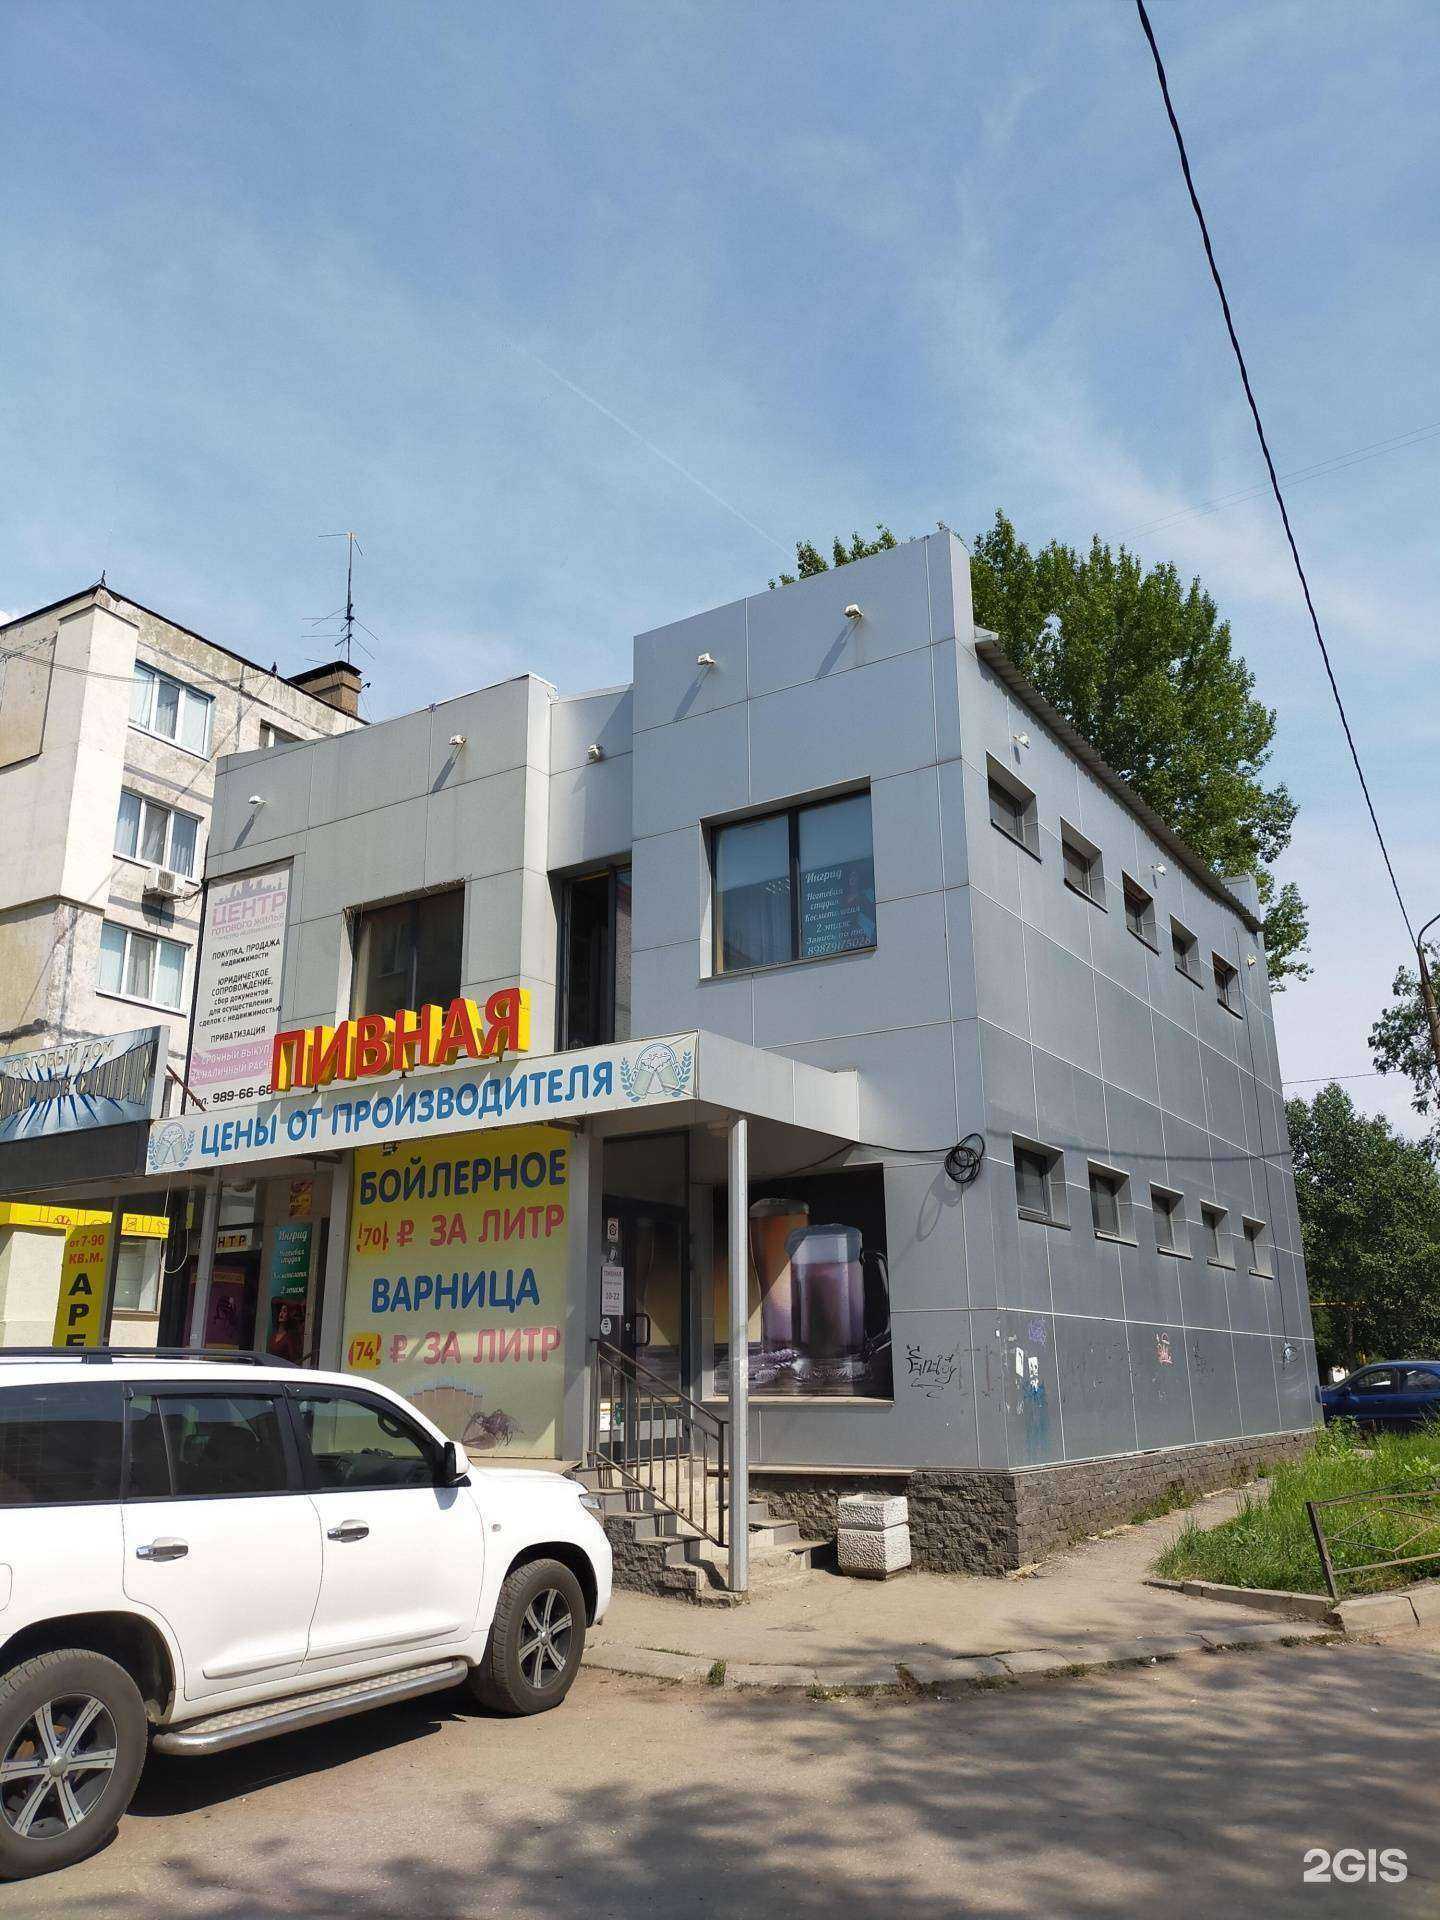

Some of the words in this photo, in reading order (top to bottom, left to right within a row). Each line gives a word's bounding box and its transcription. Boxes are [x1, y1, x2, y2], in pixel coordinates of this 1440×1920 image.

[212, 892, 287, 929] ЦЕНТР
[212, 946, 245, 961] ПОКУПКА,
[246, 938, 281, 953] ПРОДАЖА
[221, 951, 269, 968] недвижимости
[217, 967, 270, 987] ЮРИДИЧЕСКОЕ
[208, 1006, 221, 1018] для
[222, 997, 273, 1014] осуществления
[214, 995, 229, 1006] сбор
[229, 988, 269, 1004] документов
[199, 1015, 222, 1029] сделок
[228, 1005, 282, 1022] недвижимостью
[210, 1025, 266, 1044] ПРИВАТИЗАЦИЯ
[271, 988, 529, 1092] ПИВНАЯ
[200, 1114, 276, 1155] ЦЕНЫ
[287, 1102, 329, 1140] ОТ
[331, 1061, 614, 1136] ПРОИЗВОДИТЕЛЯ
[360, 1149, 566, 1205] БОЙЛЕРНОЕ
[430, 1212, 467, 1246] ЗА
[478, 1204, 565, 1243] ЛИТР
[371, 1267, 540, 1314] ВАРНИЦА
[423, 1330, 462, 1365] ЗА
[473, 1326, 561, 1363] ЛИТР
